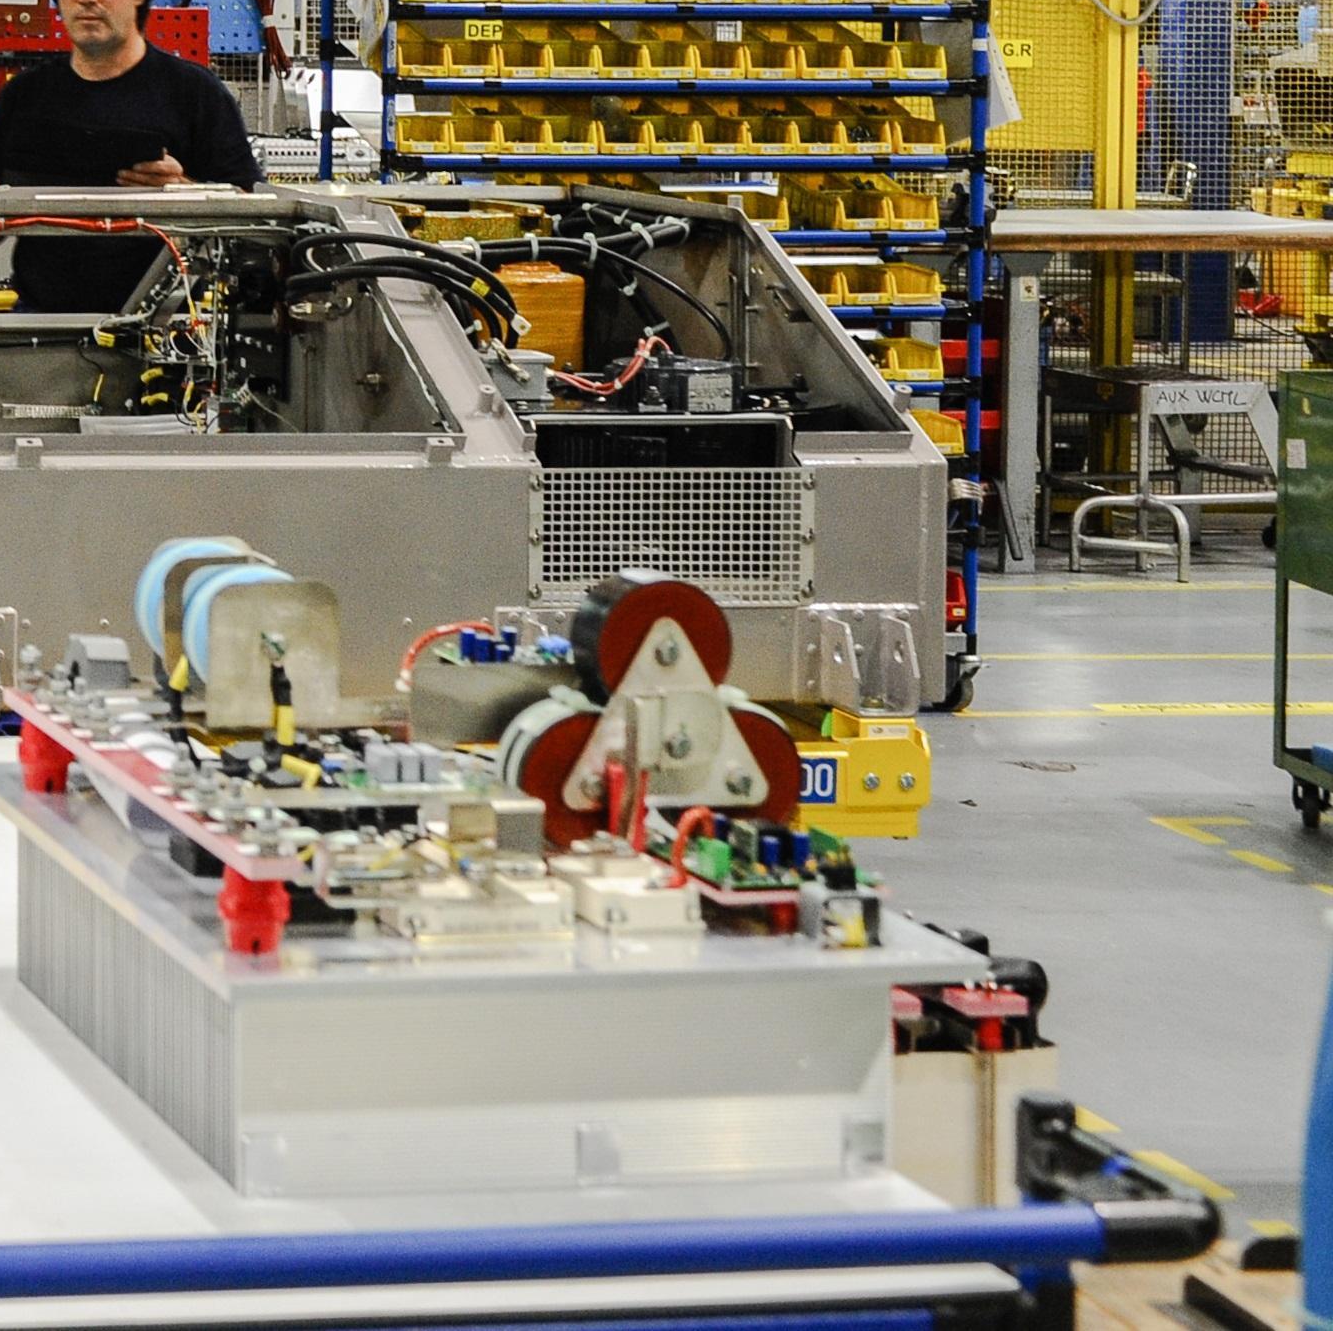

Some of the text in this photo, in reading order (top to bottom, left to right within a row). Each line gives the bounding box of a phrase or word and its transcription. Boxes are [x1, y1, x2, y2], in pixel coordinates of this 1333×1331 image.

[468, 24, 502, 37] DEP
[1003, 43, 1032, 57] G.R
[1157, 389, 1247, 406] AUX WCML
